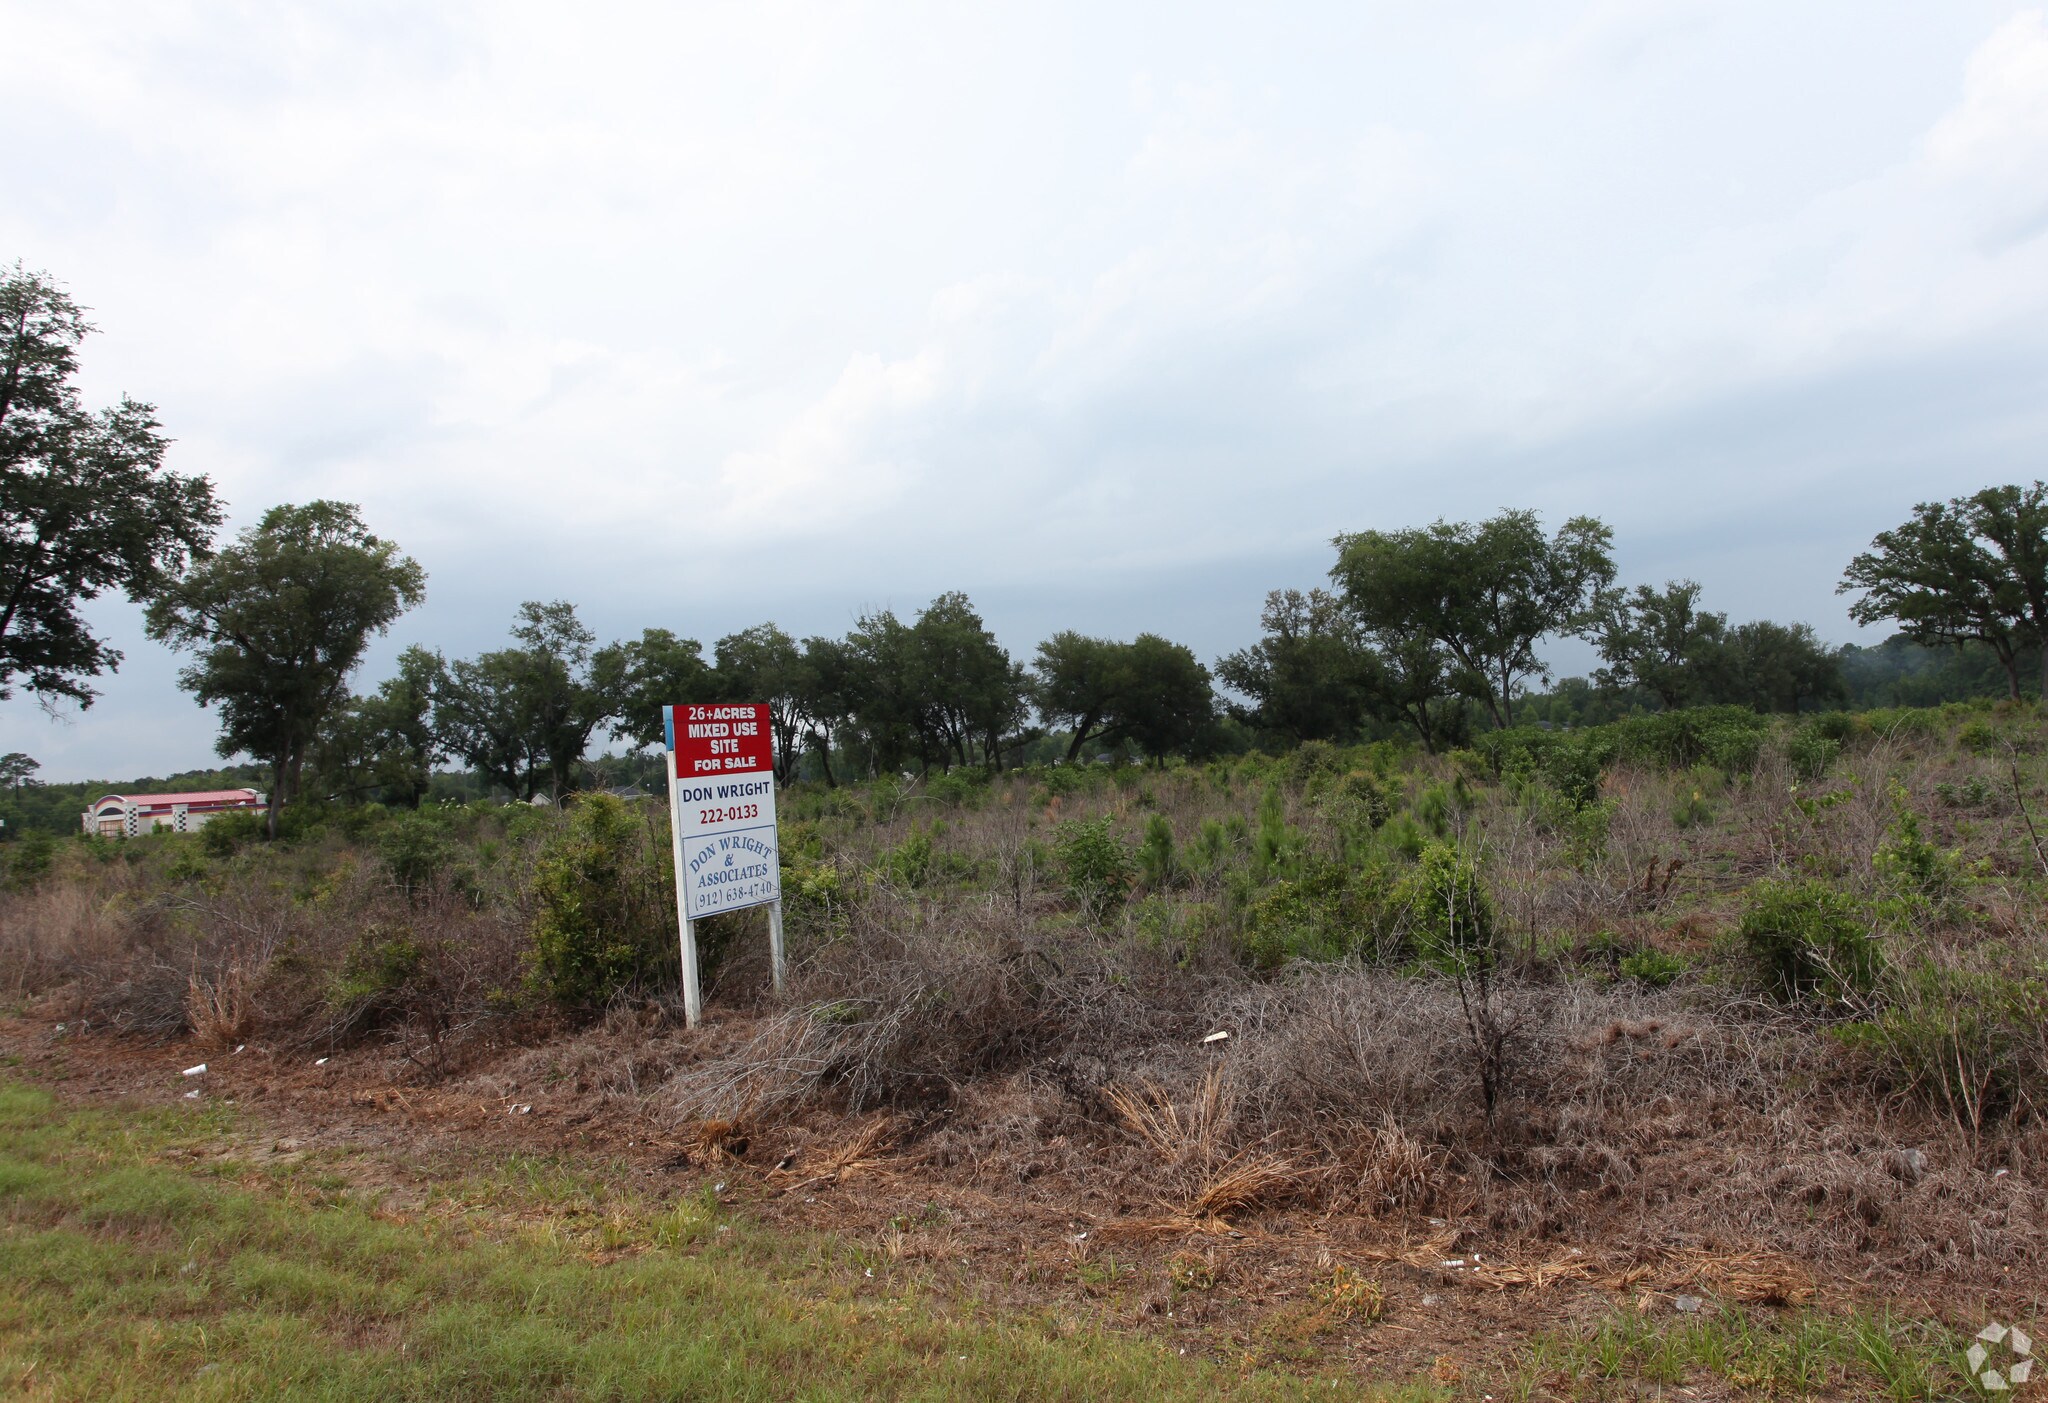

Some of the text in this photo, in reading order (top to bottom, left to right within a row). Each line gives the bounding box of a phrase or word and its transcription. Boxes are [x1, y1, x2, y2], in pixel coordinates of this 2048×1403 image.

[688, 722, 758, 738] MIXED USE
[710, 739, 739, 755] SITE
[694, 756, 757, 772] FOR SALE
[683, 781, 770, 803] DON WRIGHT
[700, 804, 758, 824] 222-0133
[689, 836, 772, 874] DON WRIGHT
[724, 853, 734, 867] &
[697, 863, 768, 888] ASSOCIATES
[694, 881, 772, 911] (912) 638-4740
